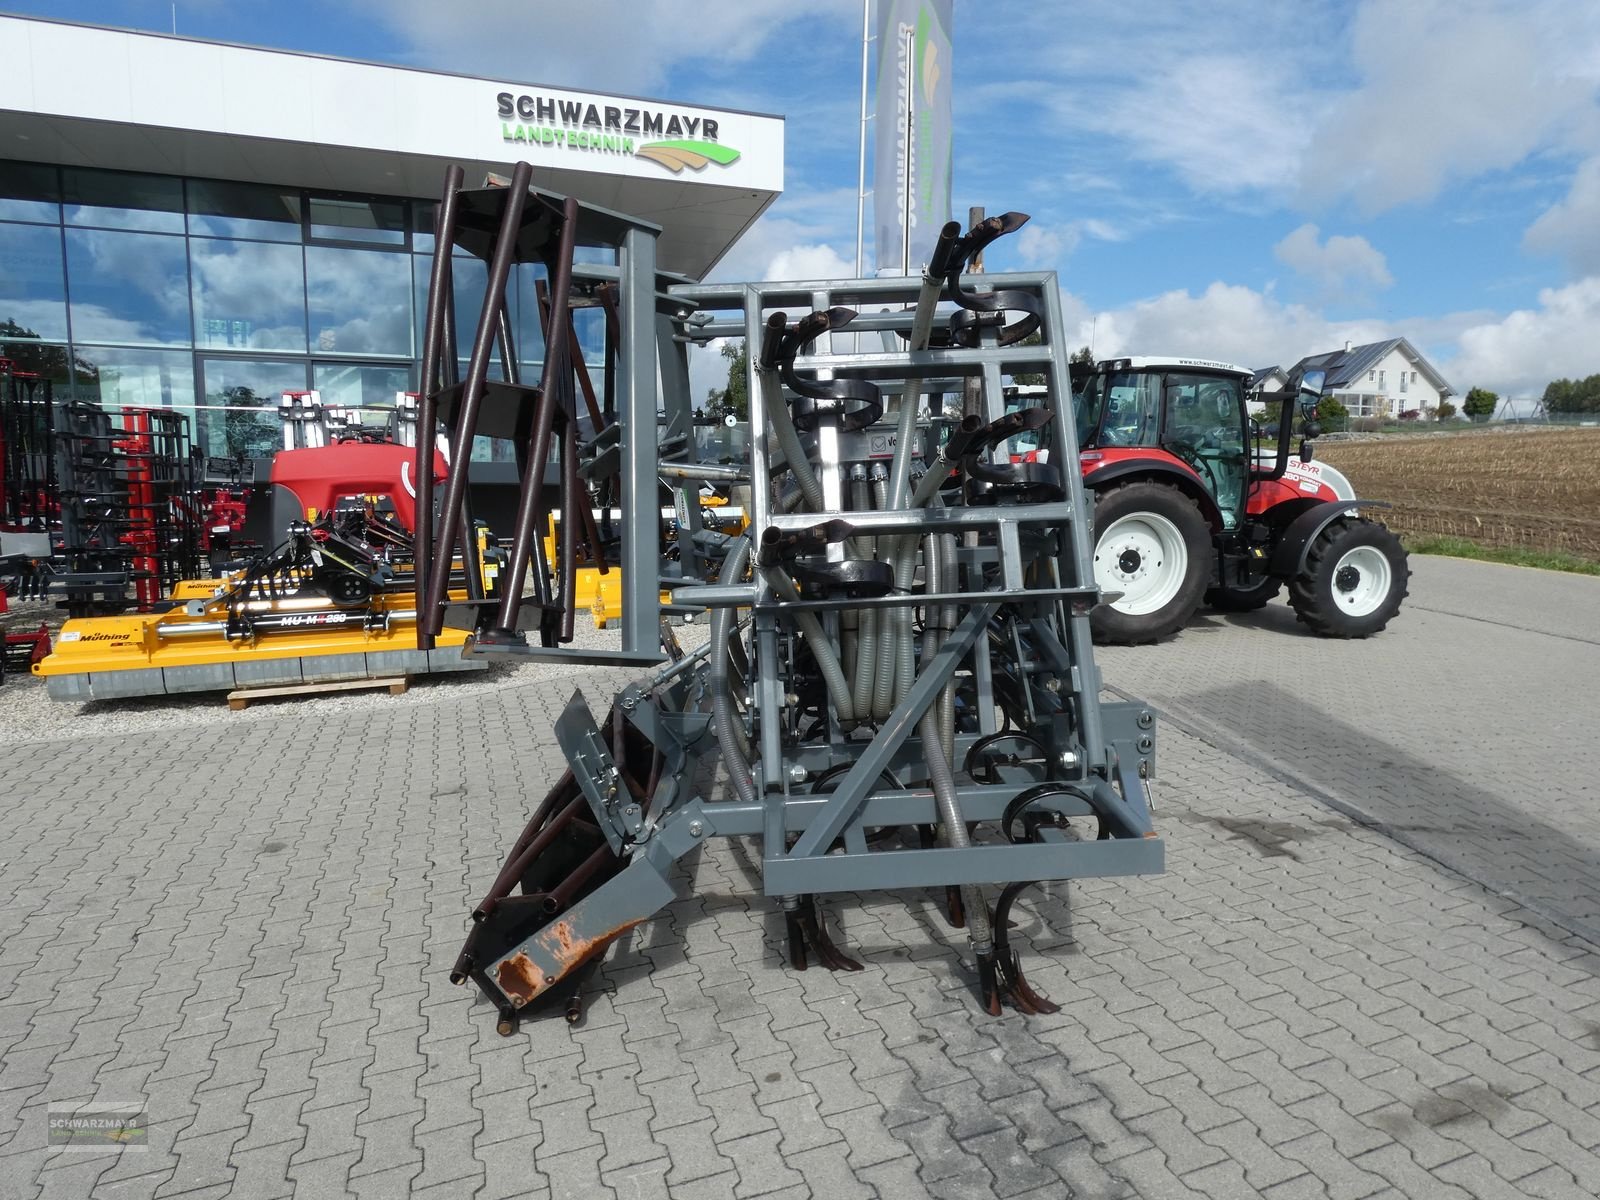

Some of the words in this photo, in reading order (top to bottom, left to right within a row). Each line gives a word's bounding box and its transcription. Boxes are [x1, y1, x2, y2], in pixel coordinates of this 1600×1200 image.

[496, 92, 719, 140] SCHWARZMAYR
[502, 123, 635, 154] LANDTECHNIK
[1179, 360, 1234, 369] www.schwarzmayr.at
[1289, 460, 1320, 475] STEYR
[80, 632, 131, 642] Müthing
